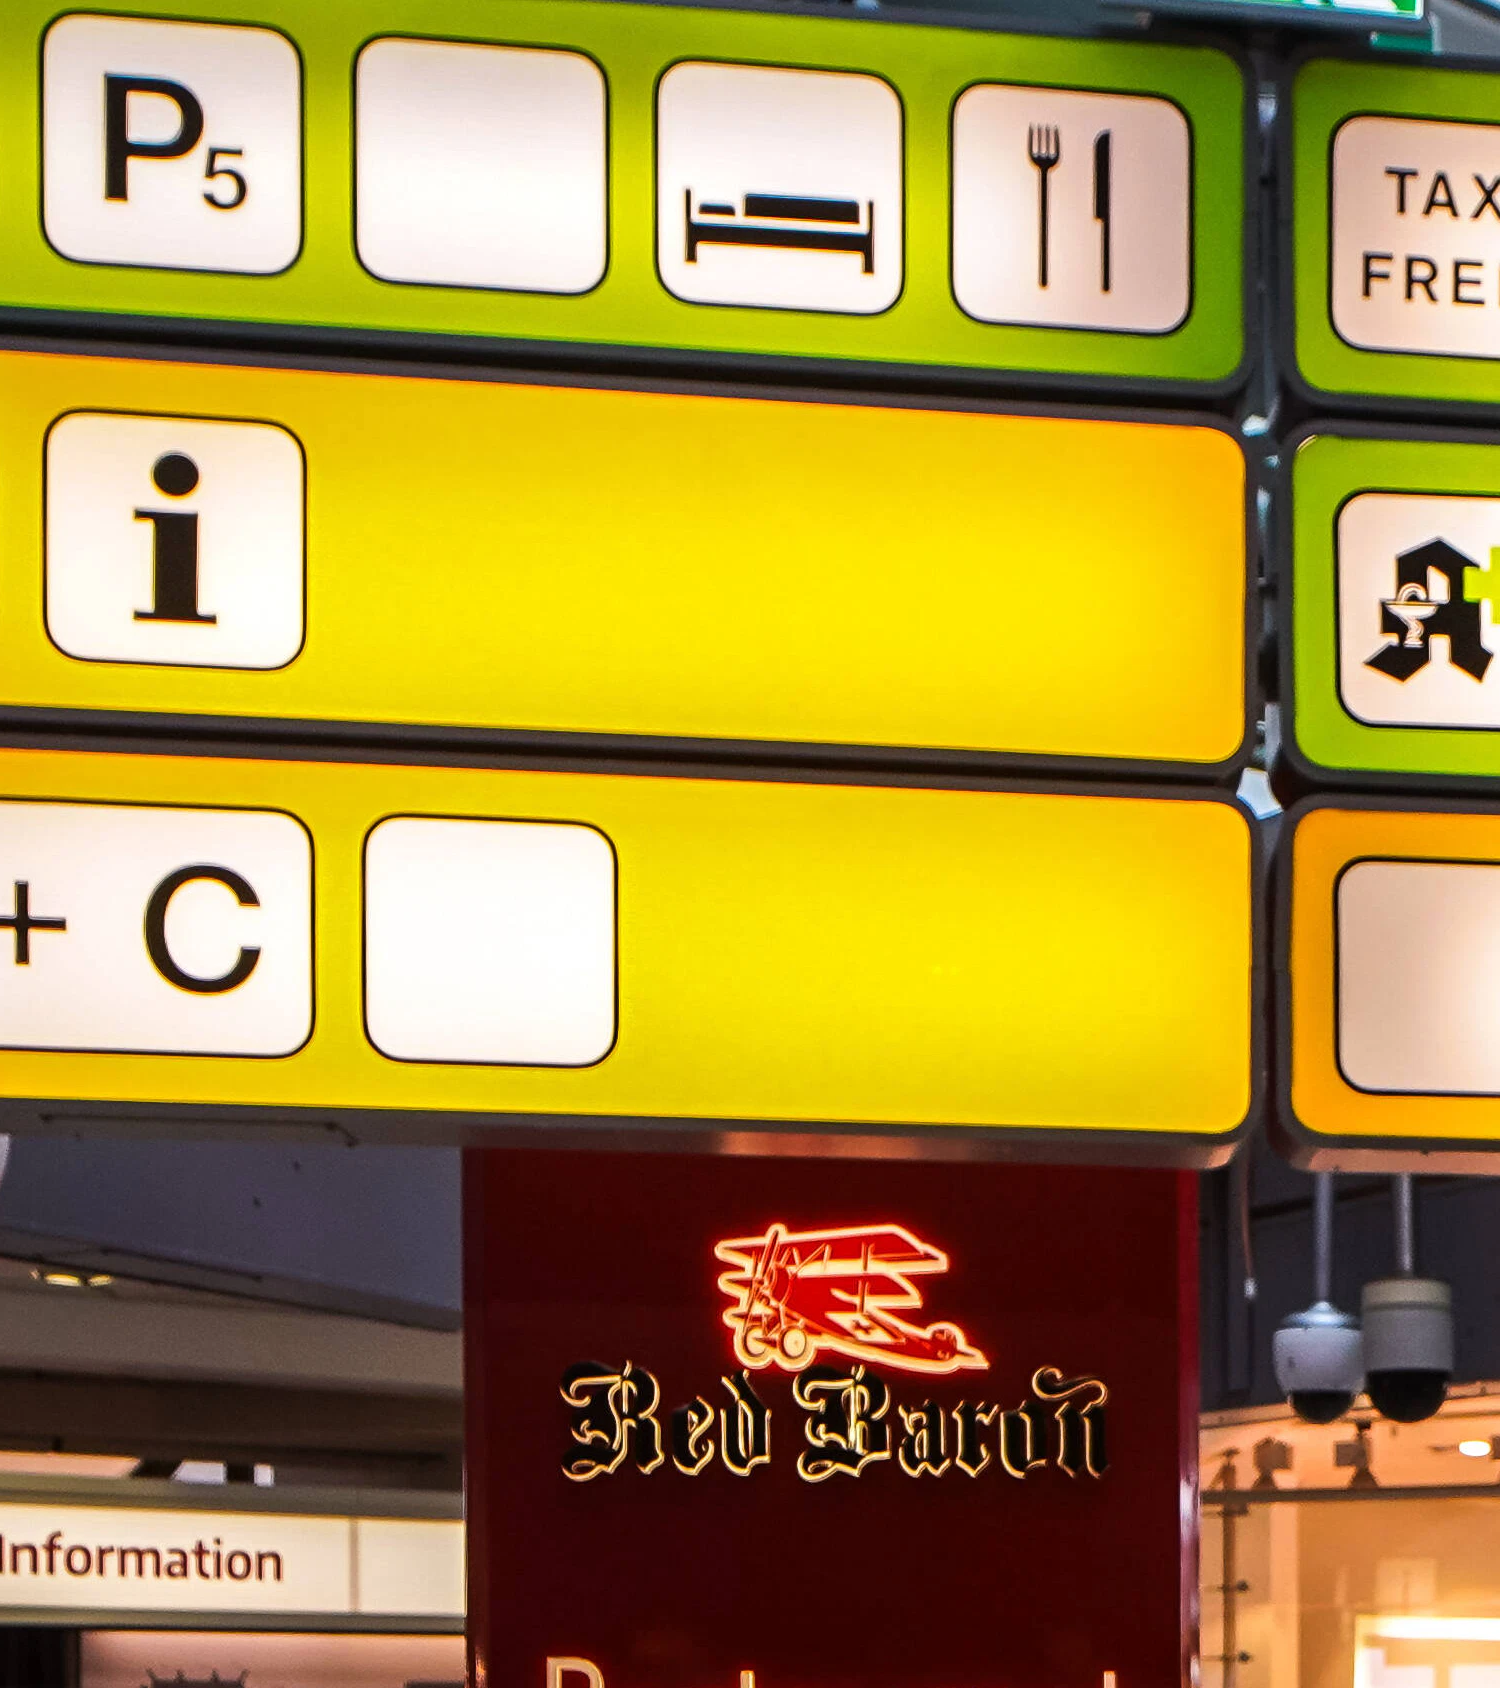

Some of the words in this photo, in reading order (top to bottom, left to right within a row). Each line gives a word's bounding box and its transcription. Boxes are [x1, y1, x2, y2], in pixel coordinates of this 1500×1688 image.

[103, 73, 248, 210] P5
[143, 864, 262, 996] C
[560, 1360, 773, 1482] Red
[794, 1363, 1110, 1483] Baron
